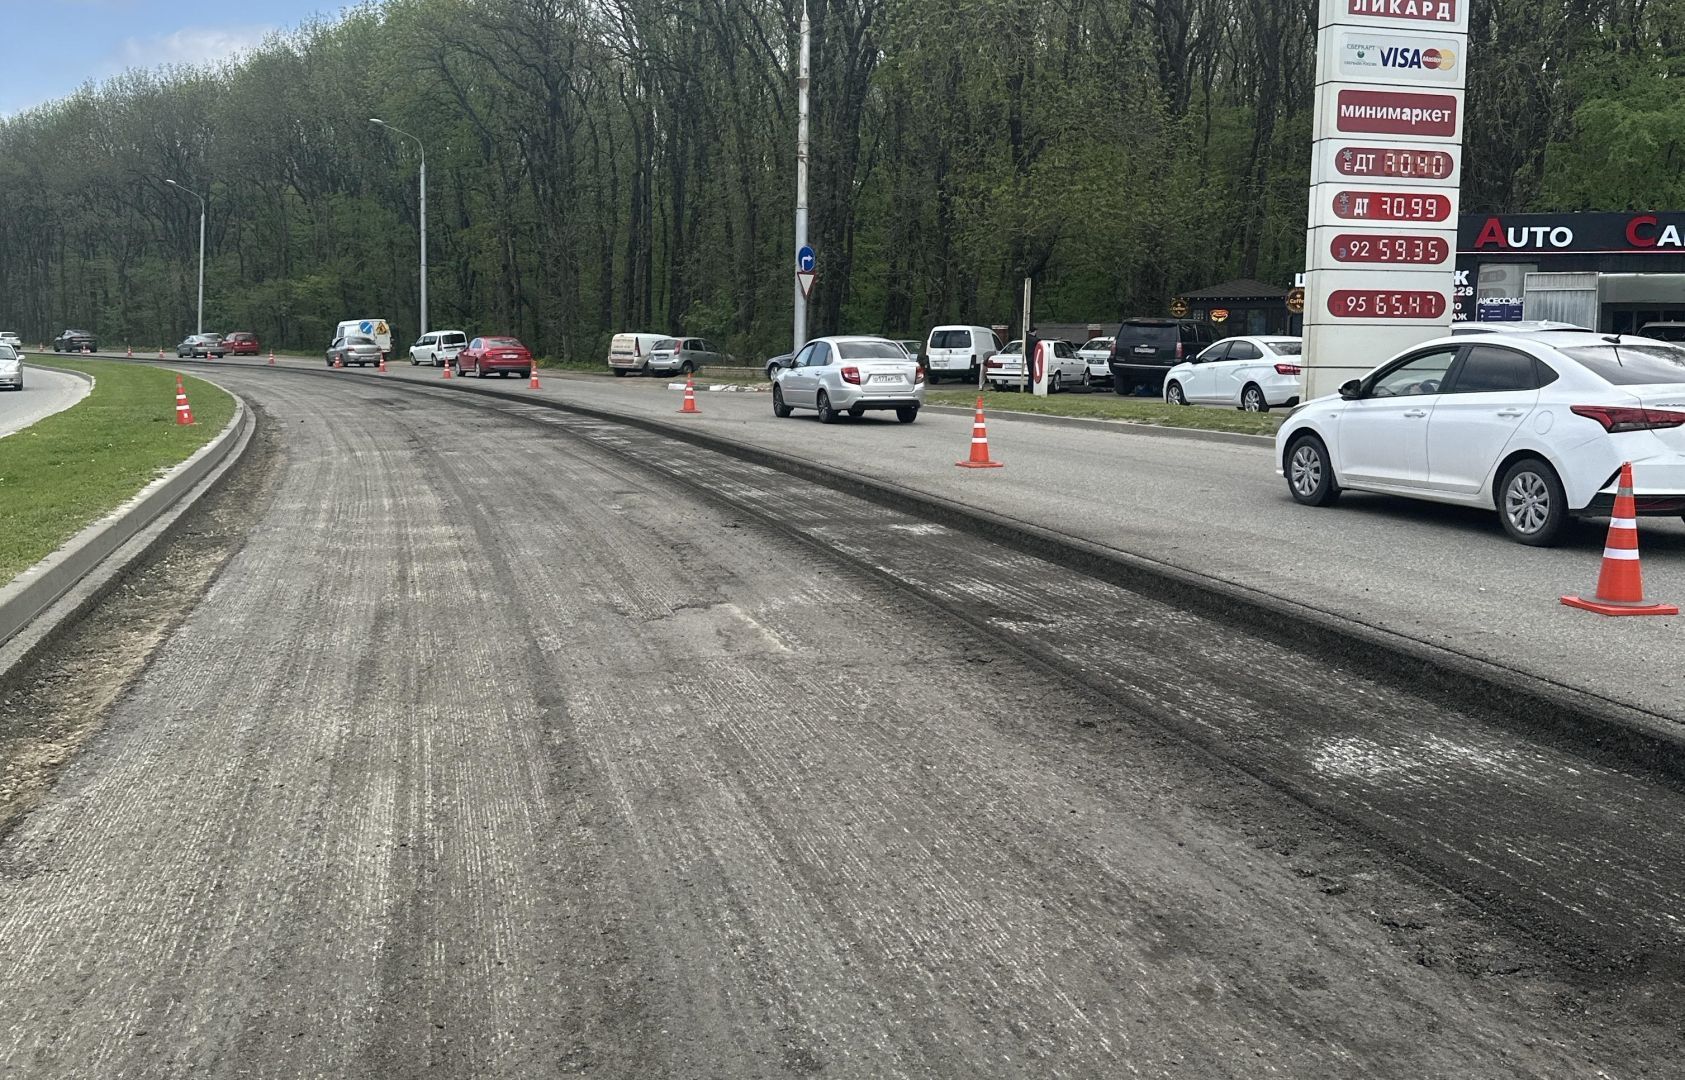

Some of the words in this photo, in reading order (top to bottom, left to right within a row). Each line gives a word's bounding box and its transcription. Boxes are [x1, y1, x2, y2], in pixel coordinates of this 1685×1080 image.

[1380, 47, 1422, 69] VISA
[1353, 198, 1369, 216] ДТ
[1381, 197, 1437, 218] 70.99
[1625, 215, 1685, 247] CA
[1350, 241, 1370, 256] 92
[1379, 239, 1438, 261] 59.35
[1346, 296, 1367, 312] 95
[1375, 294, 1436, 315] 65.47
